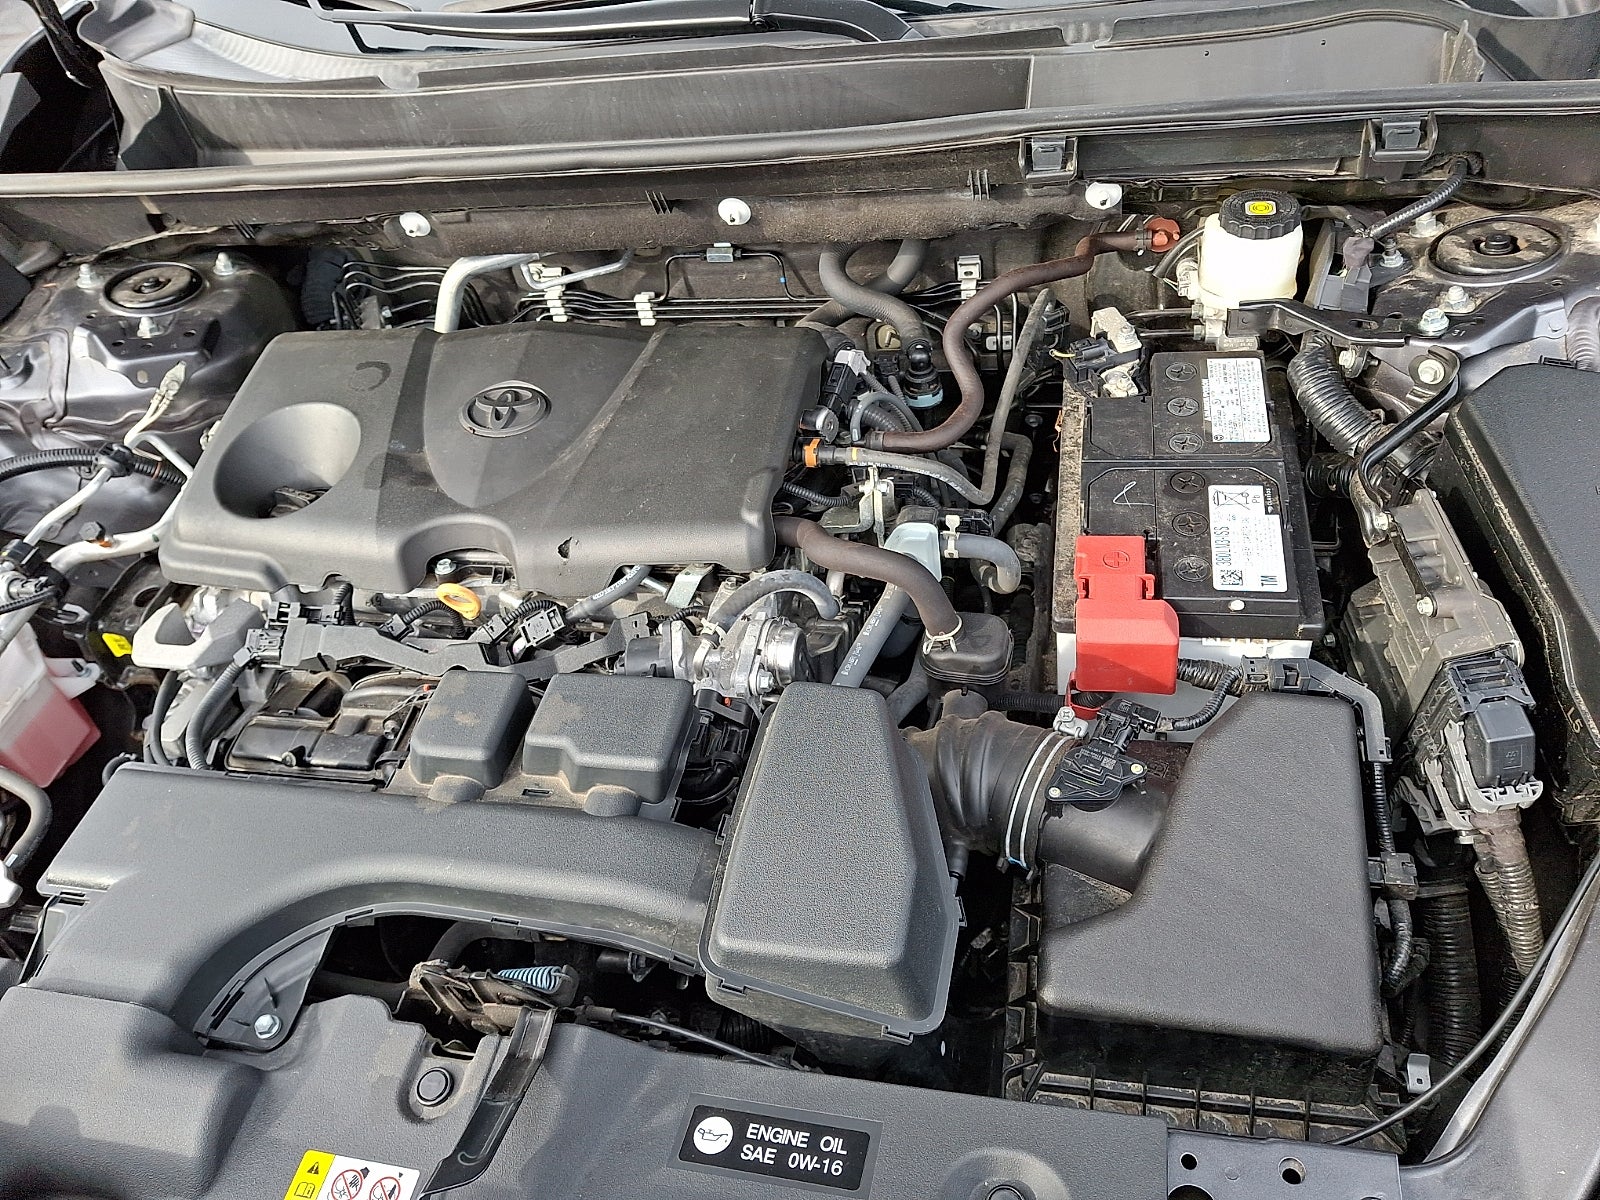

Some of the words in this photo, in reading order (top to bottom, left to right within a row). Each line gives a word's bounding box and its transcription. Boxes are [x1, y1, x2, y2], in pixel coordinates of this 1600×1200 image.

[746, 1123, 810, 1148] ENGINE
[820, 1136, 848, 1155] OIL
[740, 1144, 777, 1164] SAE
[788, 1152, 843, 1176] 0W-16
